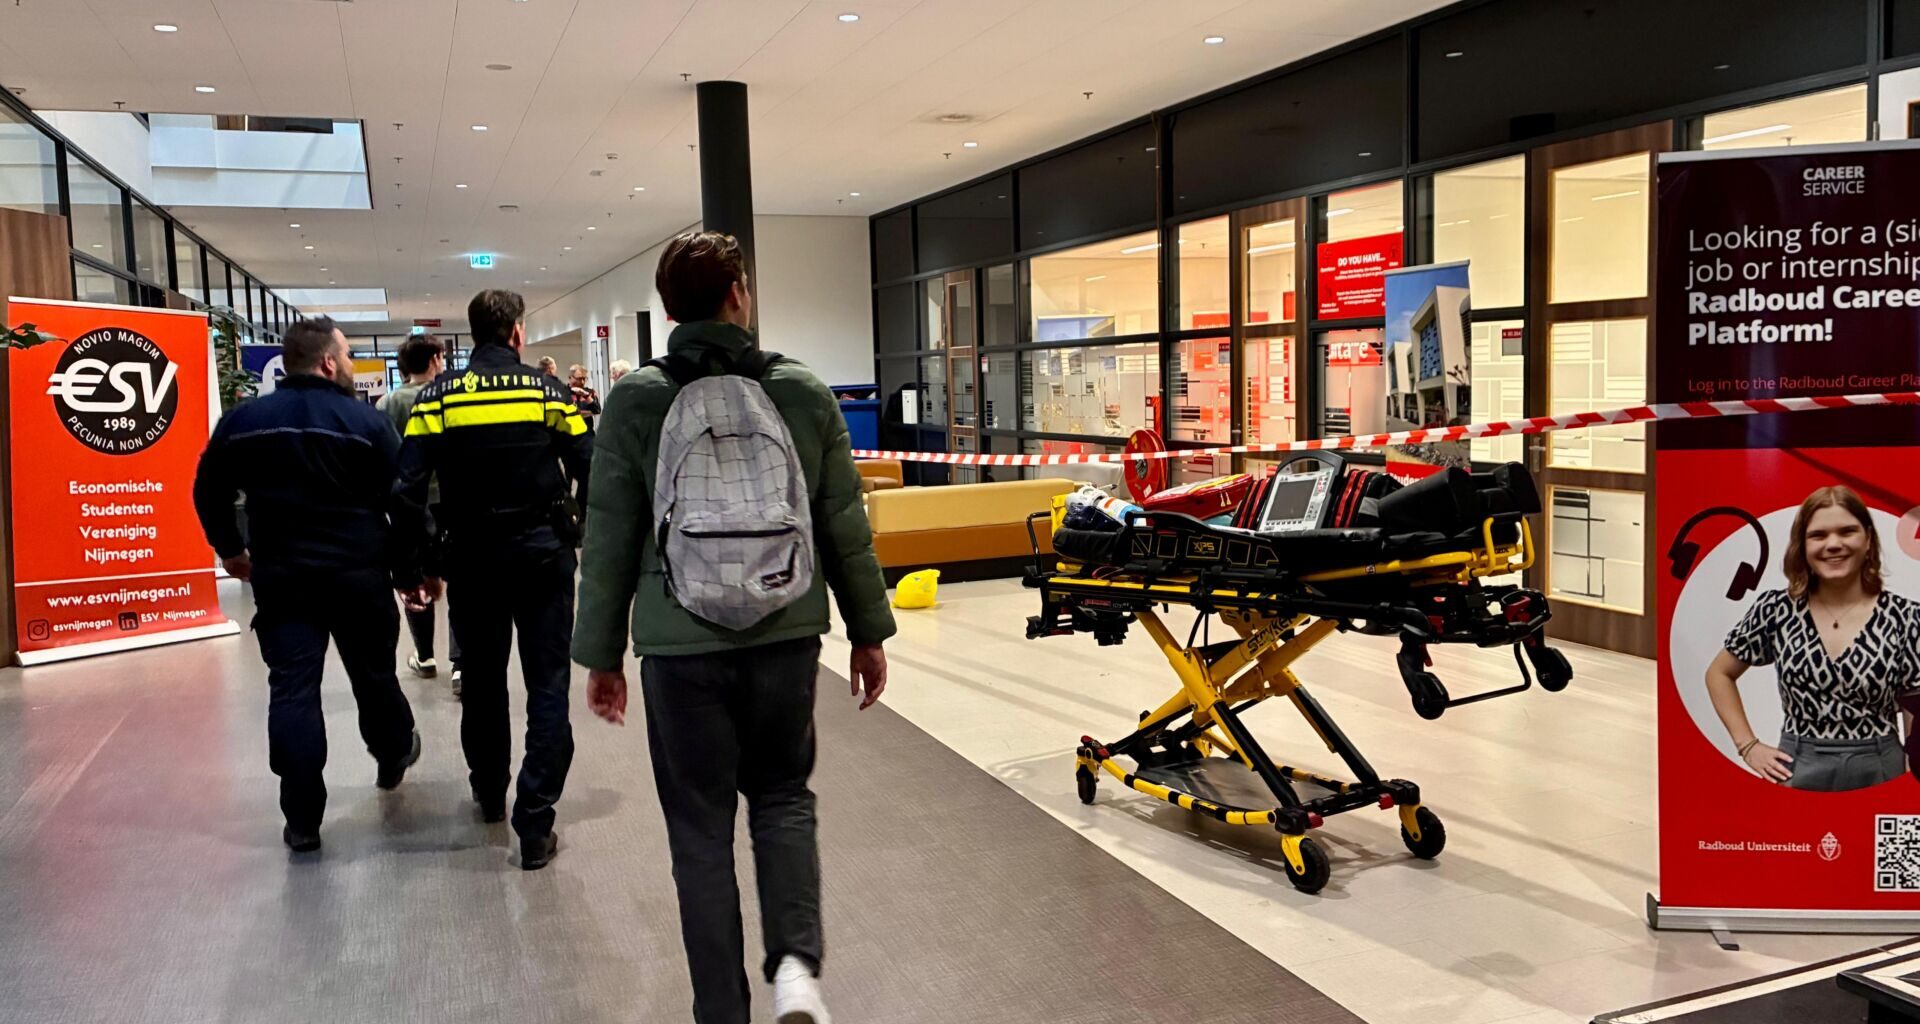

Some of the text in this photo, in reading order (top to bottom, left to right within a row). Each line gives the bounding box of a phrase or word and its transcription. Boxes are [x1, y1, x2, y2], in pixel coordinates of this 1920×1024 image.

[1803, 166, 1865, 181] CAREER
[1803, 180, 1865, 196] SERVICE
[1689, 218, 1920, 254] Looking for a (si
[1338, 257, 1347, 267] DO
[1348, 255, 1362, 265] YOU
[1685, 258, 1734, 290] job
[1742, 261, 1773, 281] or
[1688, 285, 1825, 315] Radboud
[1688, 318, 1834, 346] Platform!
[73, 331, 160, 361] NOVIO MAGUM
[1688, 379, 1715, 394] Log
[1718, 378, 1731, 390] in
[1735, 378, 1750, 390] to
[1753, 376, 1777, 389] the
[1779, 375, 1845, 389] Radboud
[1848, 374, 1896, 388] Career
[103, 417, 137, 431] 1989
[68, 415, 168, 451] PECUNIA NON OLET
[69, 479, 163, 495] Economische
[81, 503, 154, 517] Studenten
[79, 524, 157, 541] Vereniging
[1193, 541, 1215, 552] XPS
[84, 548, 154, 564] Nijmegen
[47, 583, 191, 608] www.esvnijmegen.nl
[140, 608, 207, 623] ESV Nijmegen
[53, 618, 113, 633] esvnijmegen
[1698, 840, 1811, 852] Radboud Universiteit
